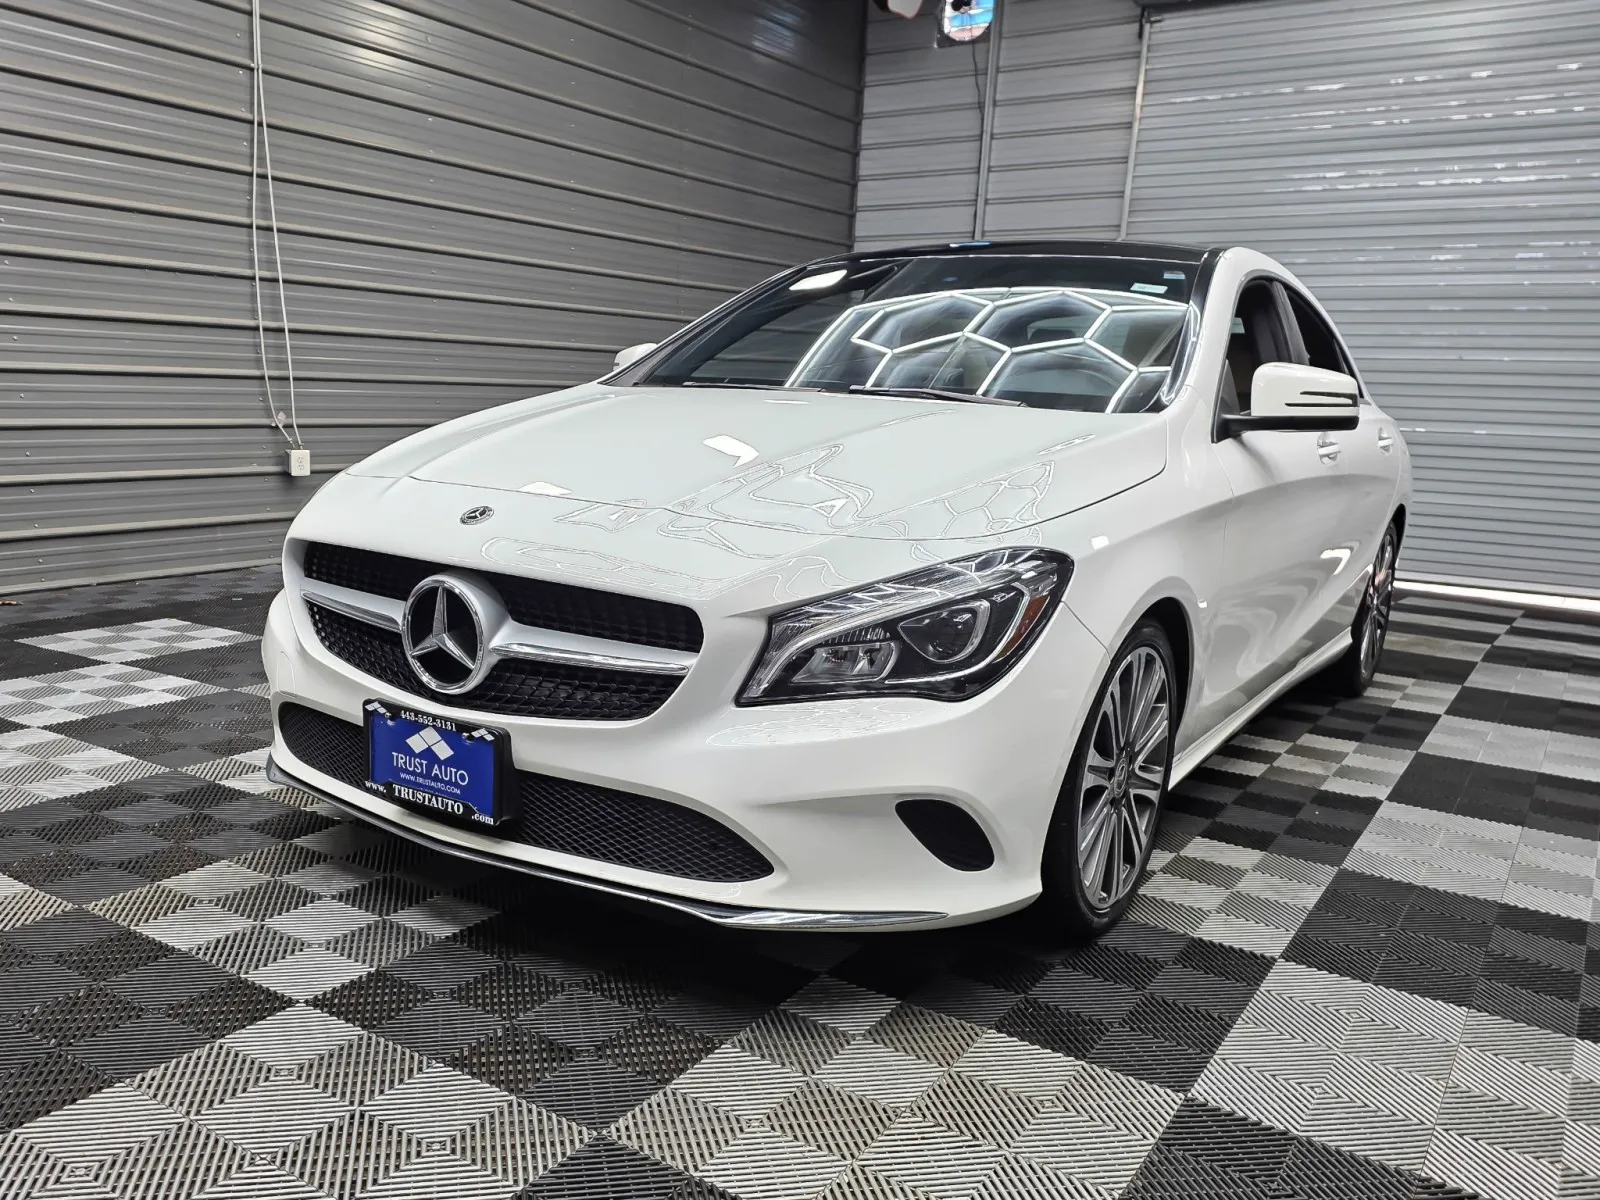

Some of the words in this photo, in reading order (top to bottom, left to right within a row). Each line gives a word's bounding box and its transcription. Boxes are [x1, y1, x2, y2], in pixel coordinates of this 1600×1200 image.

[400, 710, 457, 732] 443-552-3131
[392, 752, 428, 774] TRUST
[432, 764, 469, 786] AUTO
[399, 772, 461, 795] WWW.TRUSTAUTO.COM
[364, 780, 387, 793] www.
[392, 784, 464, 815] TRUSTAUTO
[471, 813, 494, 825] .com
